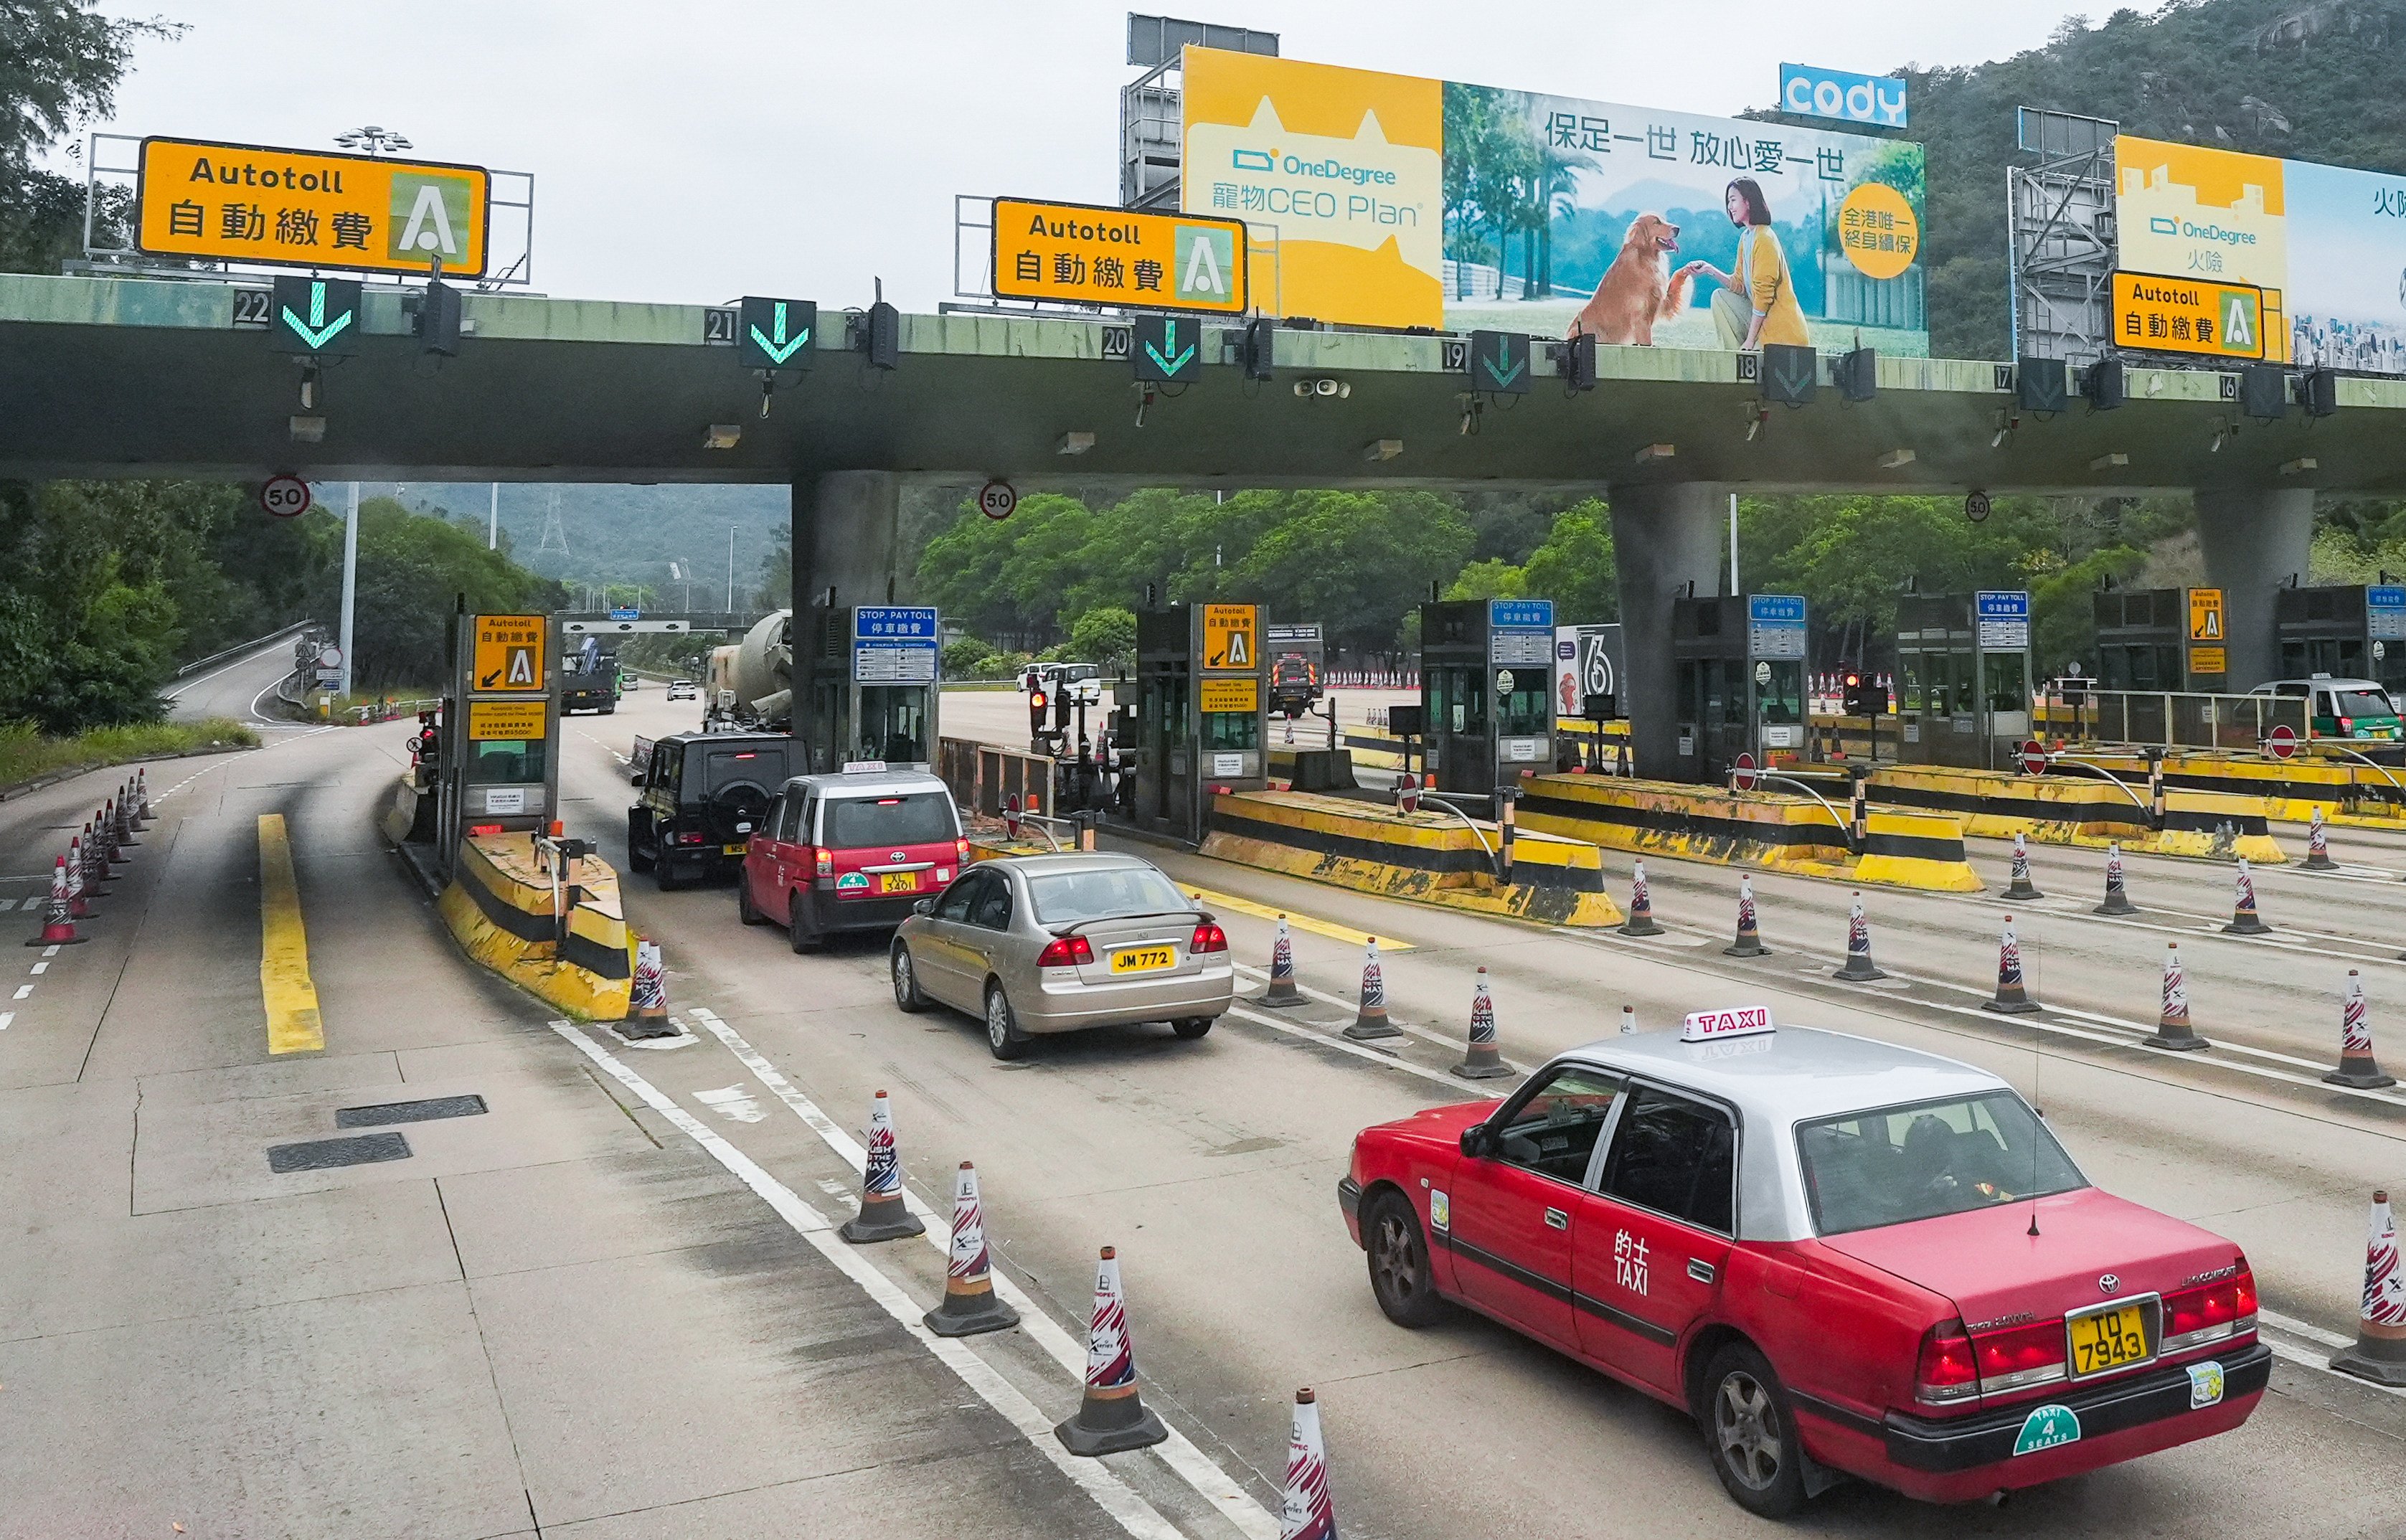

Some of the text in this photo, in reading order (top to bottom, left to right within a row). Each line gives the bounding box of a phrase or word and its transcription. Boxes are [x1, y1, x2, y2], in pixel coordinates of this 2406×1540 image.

[1545, 112, 1845, 182] 保足一世 放心愛一世
[189, 158, 344, 194] Autotoll
[1283, 155, 1397, 185] OneDegree
[1348, 194, 1417, 227] Plan
[1844, 207, 1911, 231] 全港唯一
[169, 198, 373, 251] 自動繳費
[1028, 214, 1141, 245] Autotoll
[2183, 222, 2257, 245] OneDegree
[1844, 229, 1912, 254] 終身續保
[1016, 250, 1164, 293] 自動繳費
[2188, 249, 2224, 273] 火險
[2133, 283, 2200, 306] Autotoll
[235, 291, 270, 323] 22
[708, 311, 732, 340] 21
[2125, 311, 2214, 344] 自動繳費
[1103, 328, 1128, 354] 20
[1444, 343, 1464, 367] 19
[1738, 355, 1756, 378] 18
[1996, 367, 2011, 388] 17
[2221, 377, 2235, 397] 16
[269, 488, 301, 506] 50
[986, 493, 1010, 508] 50
[1970, 501, 1986, 514] 50
[489, 619, 532, 628] Autotoll
[890, 611, 908, 620] PAY
[910, 611, 933, 620] TOLL
[1209, 618, 1251, 628] 自動繳費
[481, 631, 539, 643] 自動繳費
[847, 762, 884, 772] TAXI
[886, 882, 912, 892] 3401
[892, 874, 905, 883] XL
[1118, 952, 1168, 968] JM 772
[1699, 1008, 1766, 1034] TAXI
[1614, 1228, 1650, 1267] 的士
[1614, 1255, 1648, 1297] TAXI
[2090, 1312, 2122, 1341] TD
[2079, 1332, 2141, 1371] 7943
[2034, 1409, 2061, 1422] TAXI
[2042, 1419, 2055, 1436] 4
[2027, 1432, 2068, 1450] SEATS
